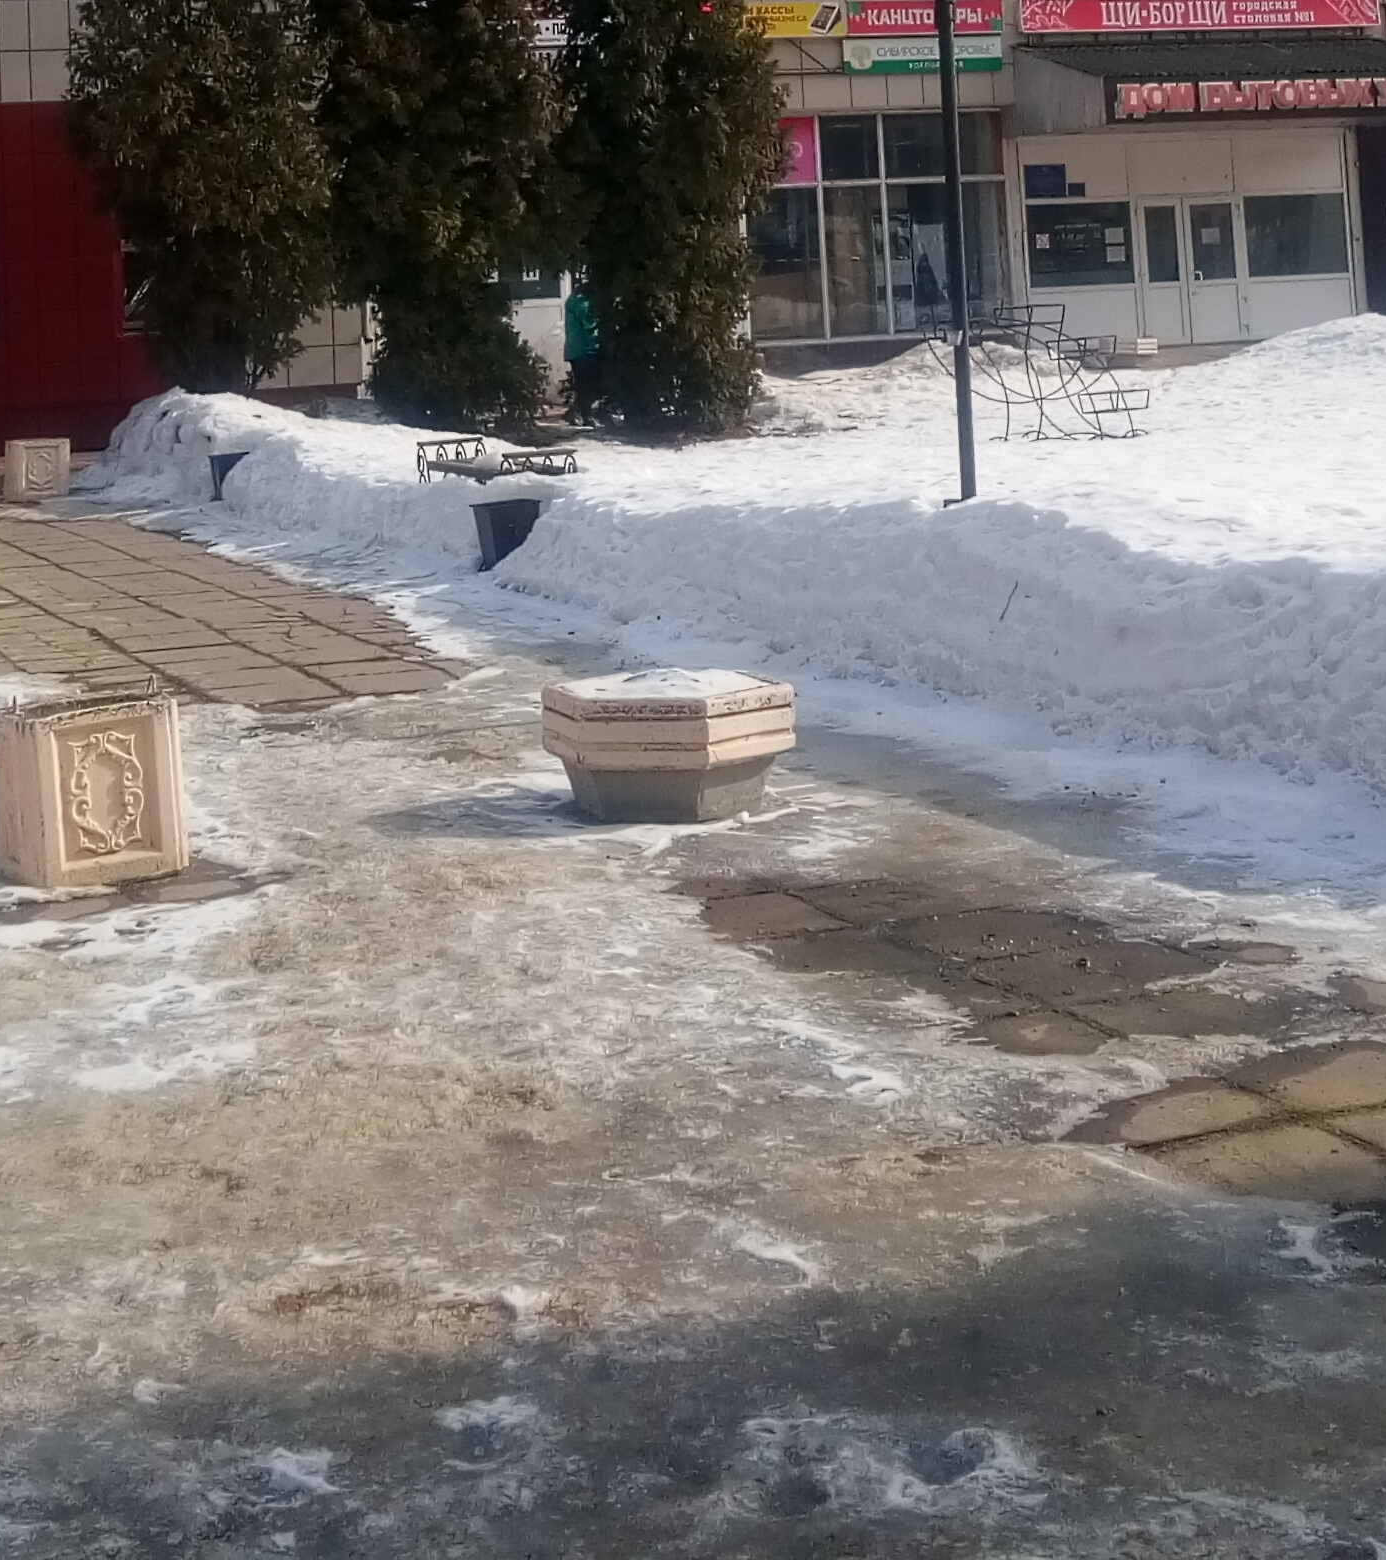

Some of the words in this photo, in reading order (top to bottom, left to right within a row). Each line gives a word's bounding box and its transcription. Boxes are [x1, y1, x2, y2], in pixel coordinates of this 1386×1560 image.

[867, 8, 982, 25] КАНЦТОРЫ
[1115, 83, 1196, 119] ДОМ
[1199, 79, 1375, 112] БЫТОВЫХ
